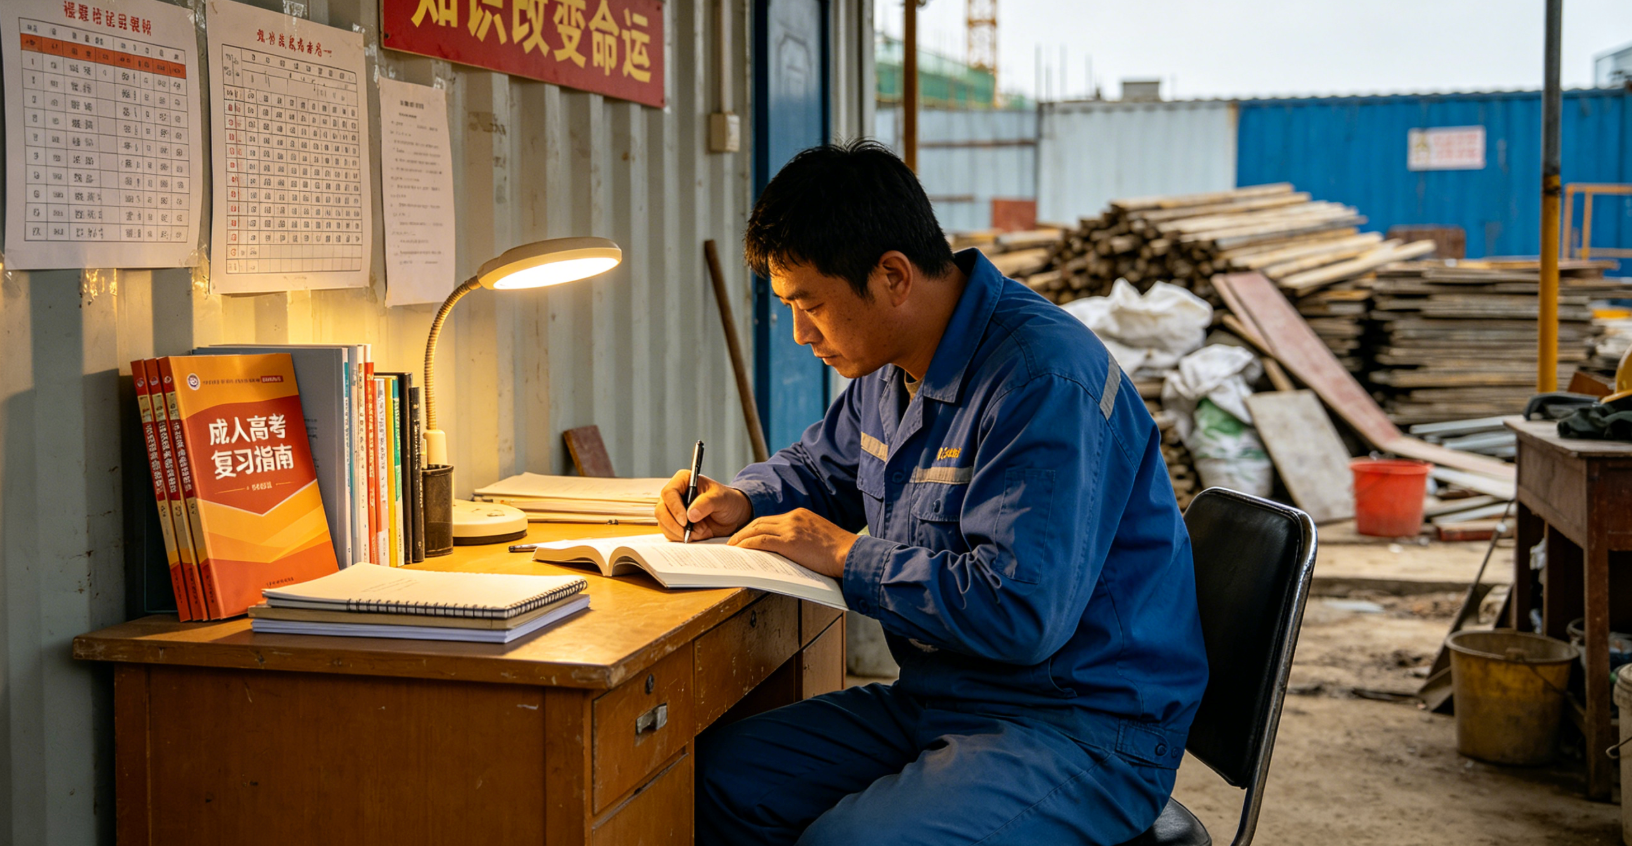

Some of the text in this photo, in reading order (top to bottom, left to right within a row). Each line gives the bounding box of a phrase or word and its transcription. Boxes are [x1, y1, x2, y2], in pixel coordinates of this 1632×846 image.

[208, 413, 286, 446] 成人高考
[210, 443, 294, 481] 复习指南
